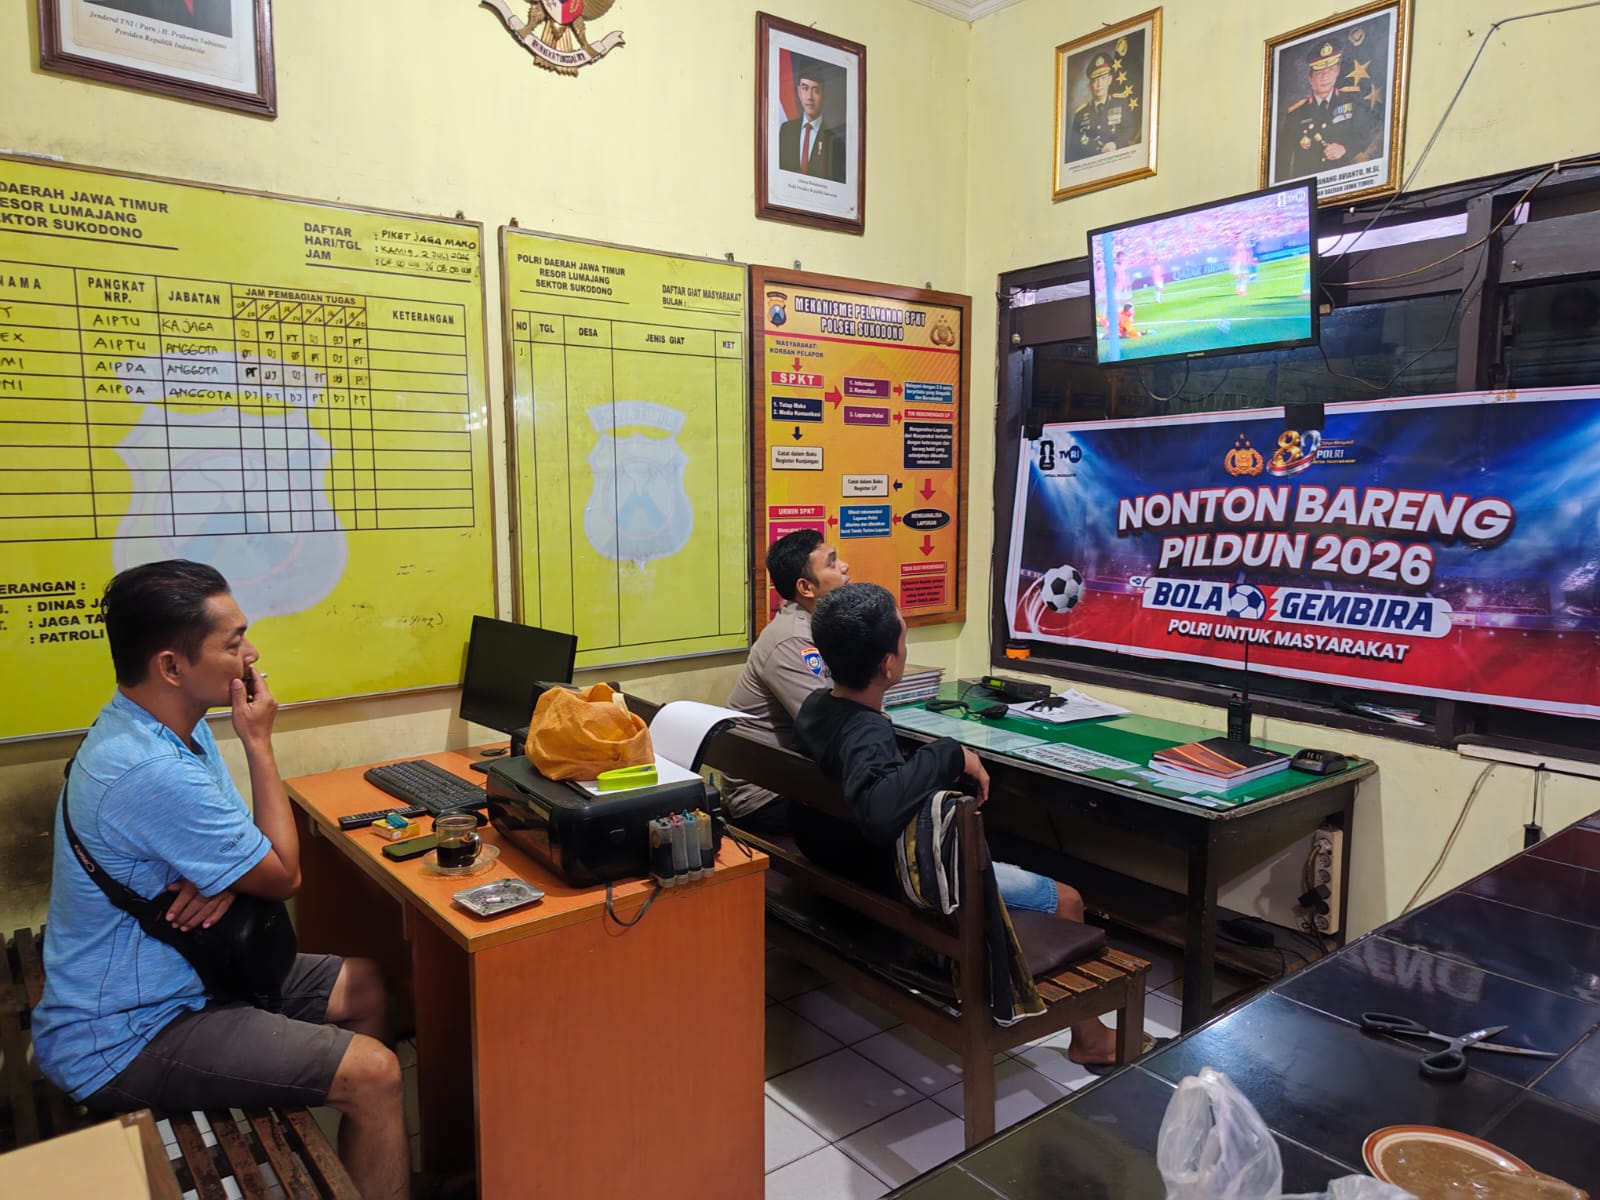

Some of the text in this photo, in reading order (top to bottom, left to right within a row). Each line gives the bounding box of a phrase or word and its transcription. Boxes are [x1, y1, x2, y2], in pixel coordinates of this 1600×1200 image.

[70, 191, 115, 206] JAWA
[119, 197, 169, 213] TIMUR
[50, 203, 137, 224] LUMAJANG
[0, 212, 143, 239] KTOR SUKODONO
[304, 222, 352, 237] DAFTAR
[305, 235, 362, 251] HARI/TGL
[381, 230, 411, 240] PIKET
[445, 239, 477, 250] MAKO
[305, 249, 331, 261] JAM
[517, 253, 625, 276] POLRI DAERAH JAWA TIMUR
[539, 268, 610, 285] RESOR LUMAJANG
[88, 277, 145, 292] PANGKAT
[536, 279, 613, 296] SEKTOR SUKODONO
[104, 291, 132, 304] NRP.
[168, 291, 220, 305] JABATAN
[245, 288, 356, 305] JAM PEMBAGIAN TUGAS
[662, 284, 742, 302] DAFTAR GIAT MASYARAKAT
[662, 297, 683, 307] BULAN
[392, 310, 455, 325] KETERANGAN
[795, 296, 926, 327] MEKANISME PELAYANAN SPKT
[93, 314, 140, 327] AIPTU
[516, 321, 528, 331] NO
[539, 323, 555, 334] TGL
[578, 327, 598, 337] DESA
[821, 317, 904, 341] POLSEK SUKODONO
[94, 338, 146, 350] AIPTU
[645, 333, 685, 345] JENIS GIAT
[722, 340, 736, 350] KET
[166, 343, 218, 355] ANGGOTA
[797, 350, 824, 358] PELAPOR
[95, 361, 146, 374] AIPDA
[779, 372, 815, 385] SPKT
[96, 384, 145, 396] AIPDA
[1059, 448, 1081, 461] TVRI
[1316, 449, 1344, 459] POLRI
[1117, 486, 1513, 540] NONTON BARENG
[1159, 533, 1434, 586] PILDUN 2026
[0, 581, 76, 594] ERANGAN
[37, 599, 85, 612] DINAS
[1152, 581, 1434, 632] BOLA GEMBIRA
[39, 615, 80, 628] JAGA
[40, 629, 104, 643] PATROLI
[1168, 618, 1409, 662] POLRI UNTUK MASYARAKAT
